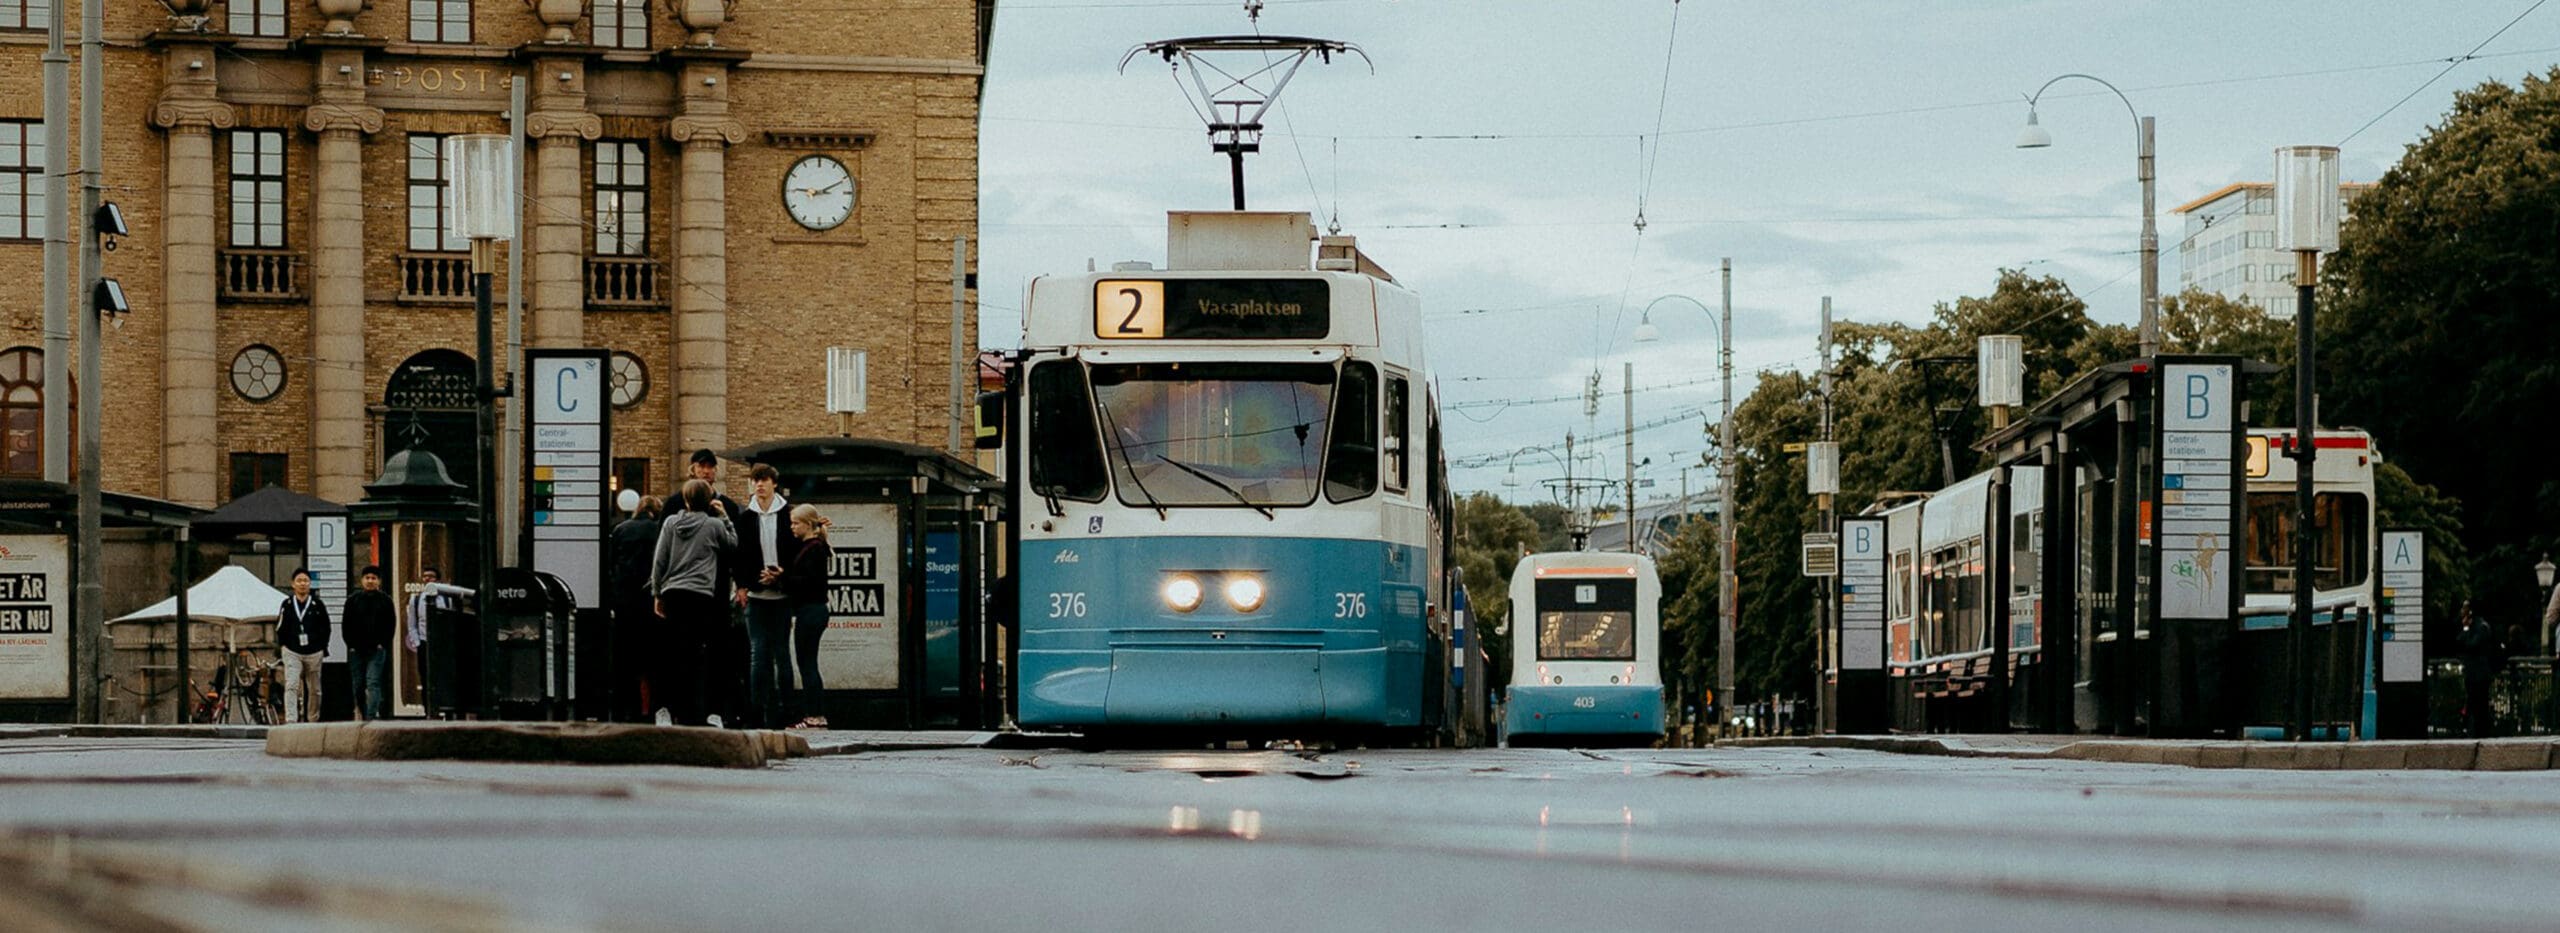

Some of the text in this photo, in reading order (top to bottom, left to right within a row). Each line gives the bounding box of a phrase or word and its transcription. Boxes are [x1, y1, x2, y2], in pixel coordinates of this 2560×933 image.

[394, 66, 491, 92] POST
[1118, 288, 1143, 333] 2
[1199, 299, 1301, 319] Vasaplatsen
[557, 367, 578, 412] C
[2186, 374, 2210, 420] B
[540, 440, 576, 448] stationen
[2168, 446, 2206, 455] stationen
[0, 502, 50, 510] alstationen
[321, 522, 334, 548] D
[1856, 527, 1870, 553] B
[1054, 549, 1079, 563] Ada
[2395, 538, 2410, 564] A
[925, 562, 959, 574] Skage
[20, 575, 44, 599] ÄR
[827, 586, 880, 613] NÄRA
[1583, 588, 1589, 600] 1
[1049, 592, 1086, 618] 376
[1335, 592, 1366, 618] 376
[27, 610, 50, 631] NU
[1573, 697, 1596, 708] 403
